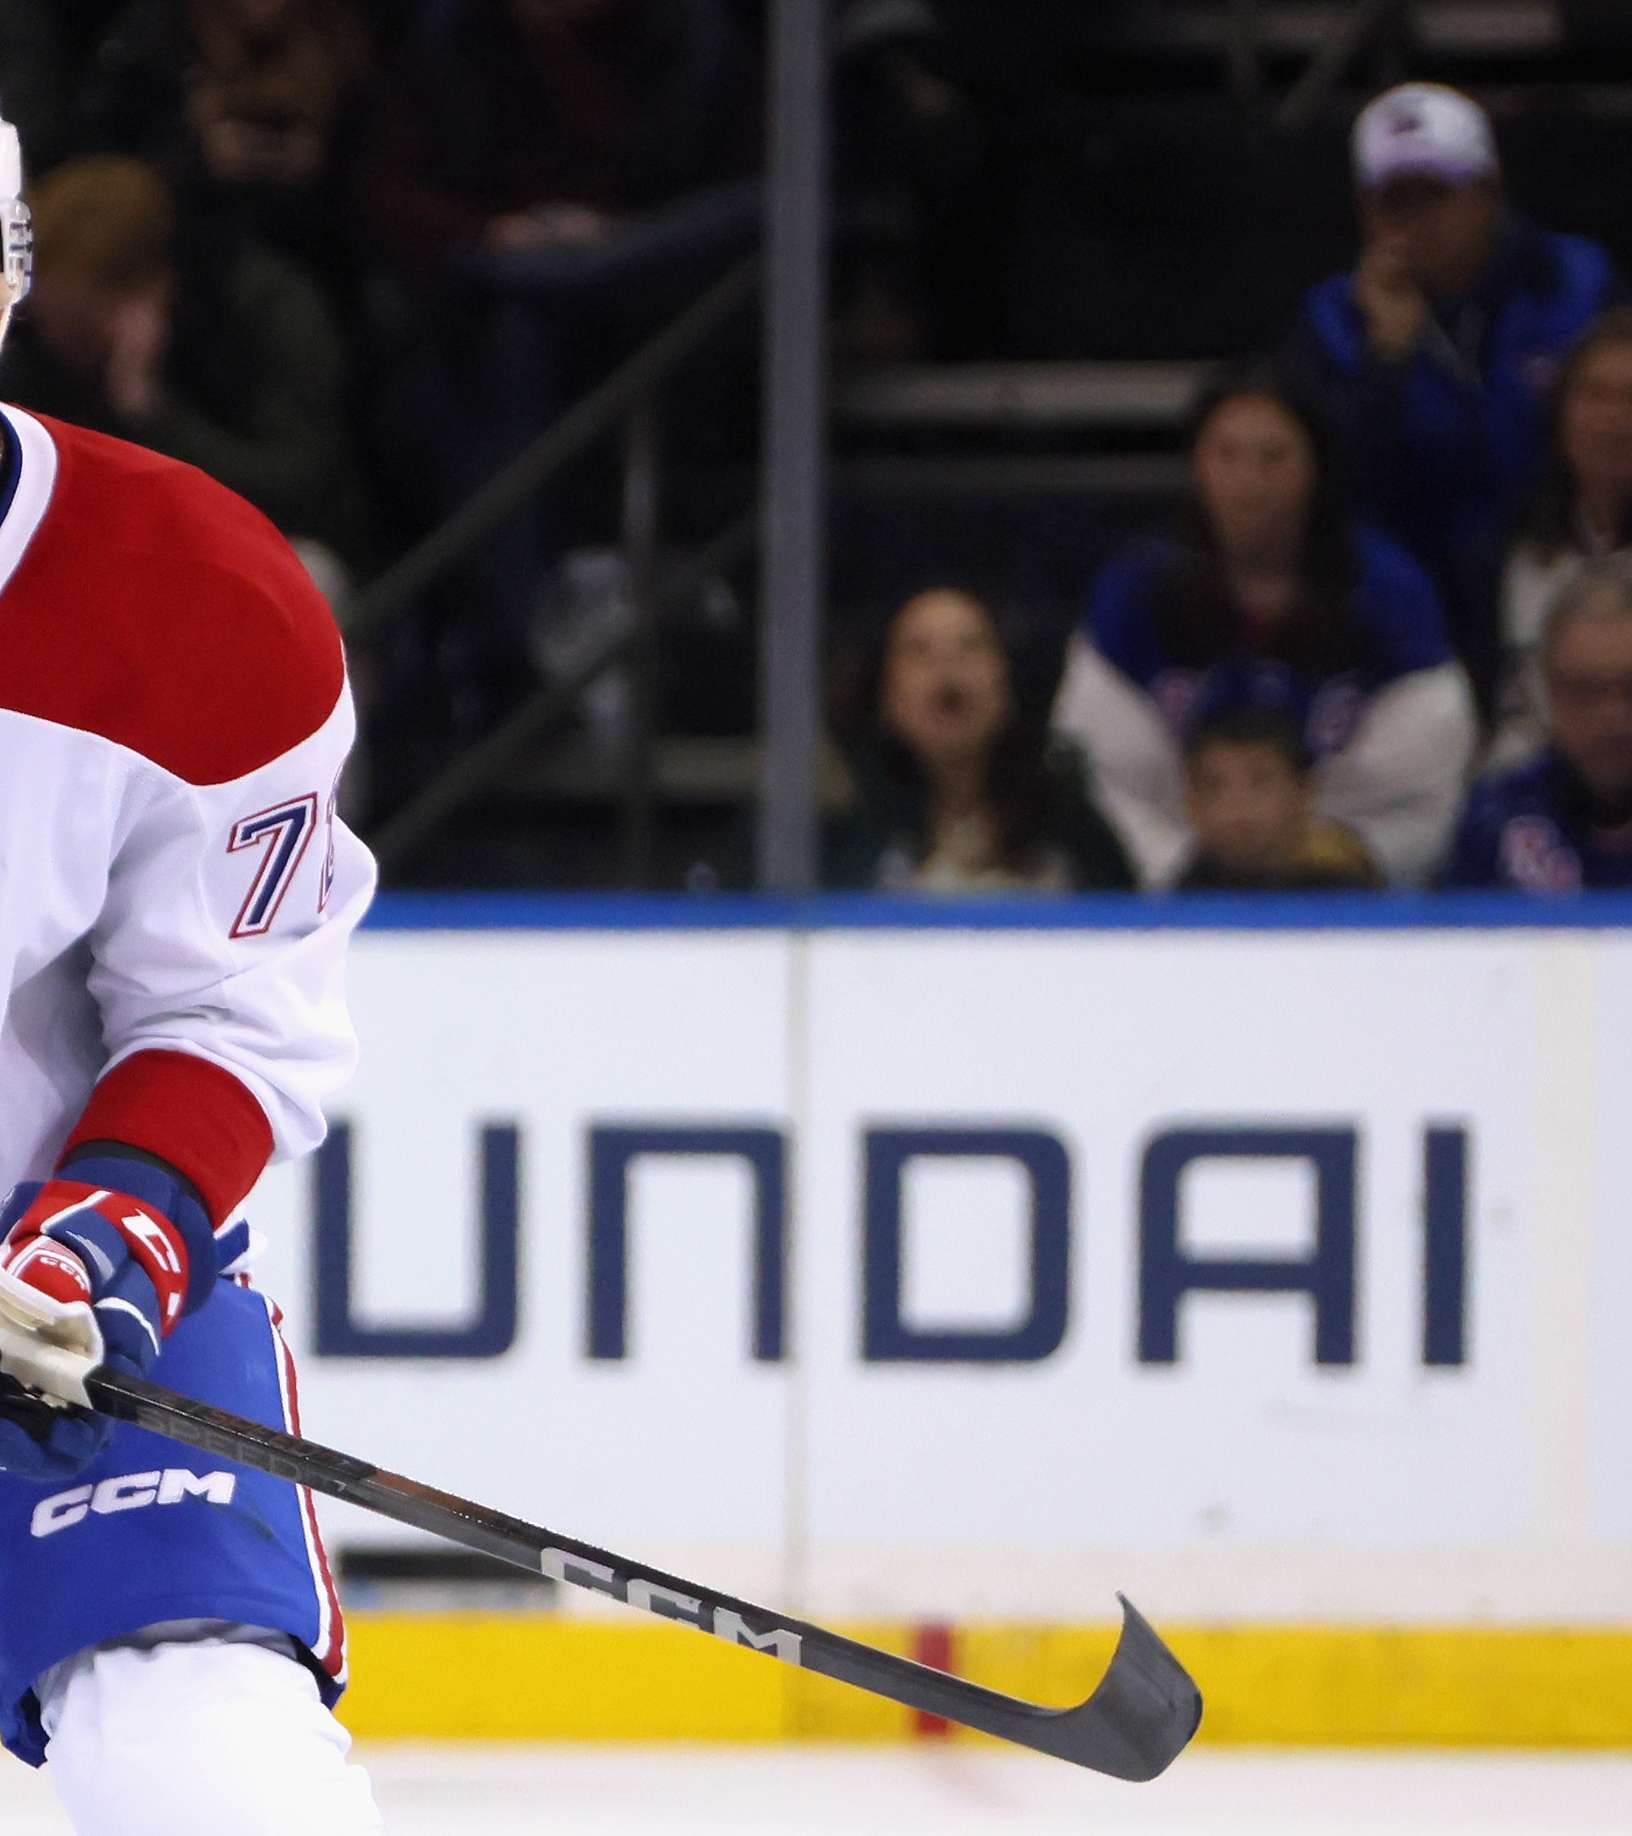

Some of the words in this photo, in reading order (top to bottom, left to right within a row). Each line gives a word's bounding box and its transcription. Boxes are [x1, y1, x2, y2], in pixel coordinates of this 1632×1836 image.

[311, 1120, 1470, 1366] UNDAI
[30, 1468, 236, 1538] CCM
[540, 1546, 803, 1667] CCM
